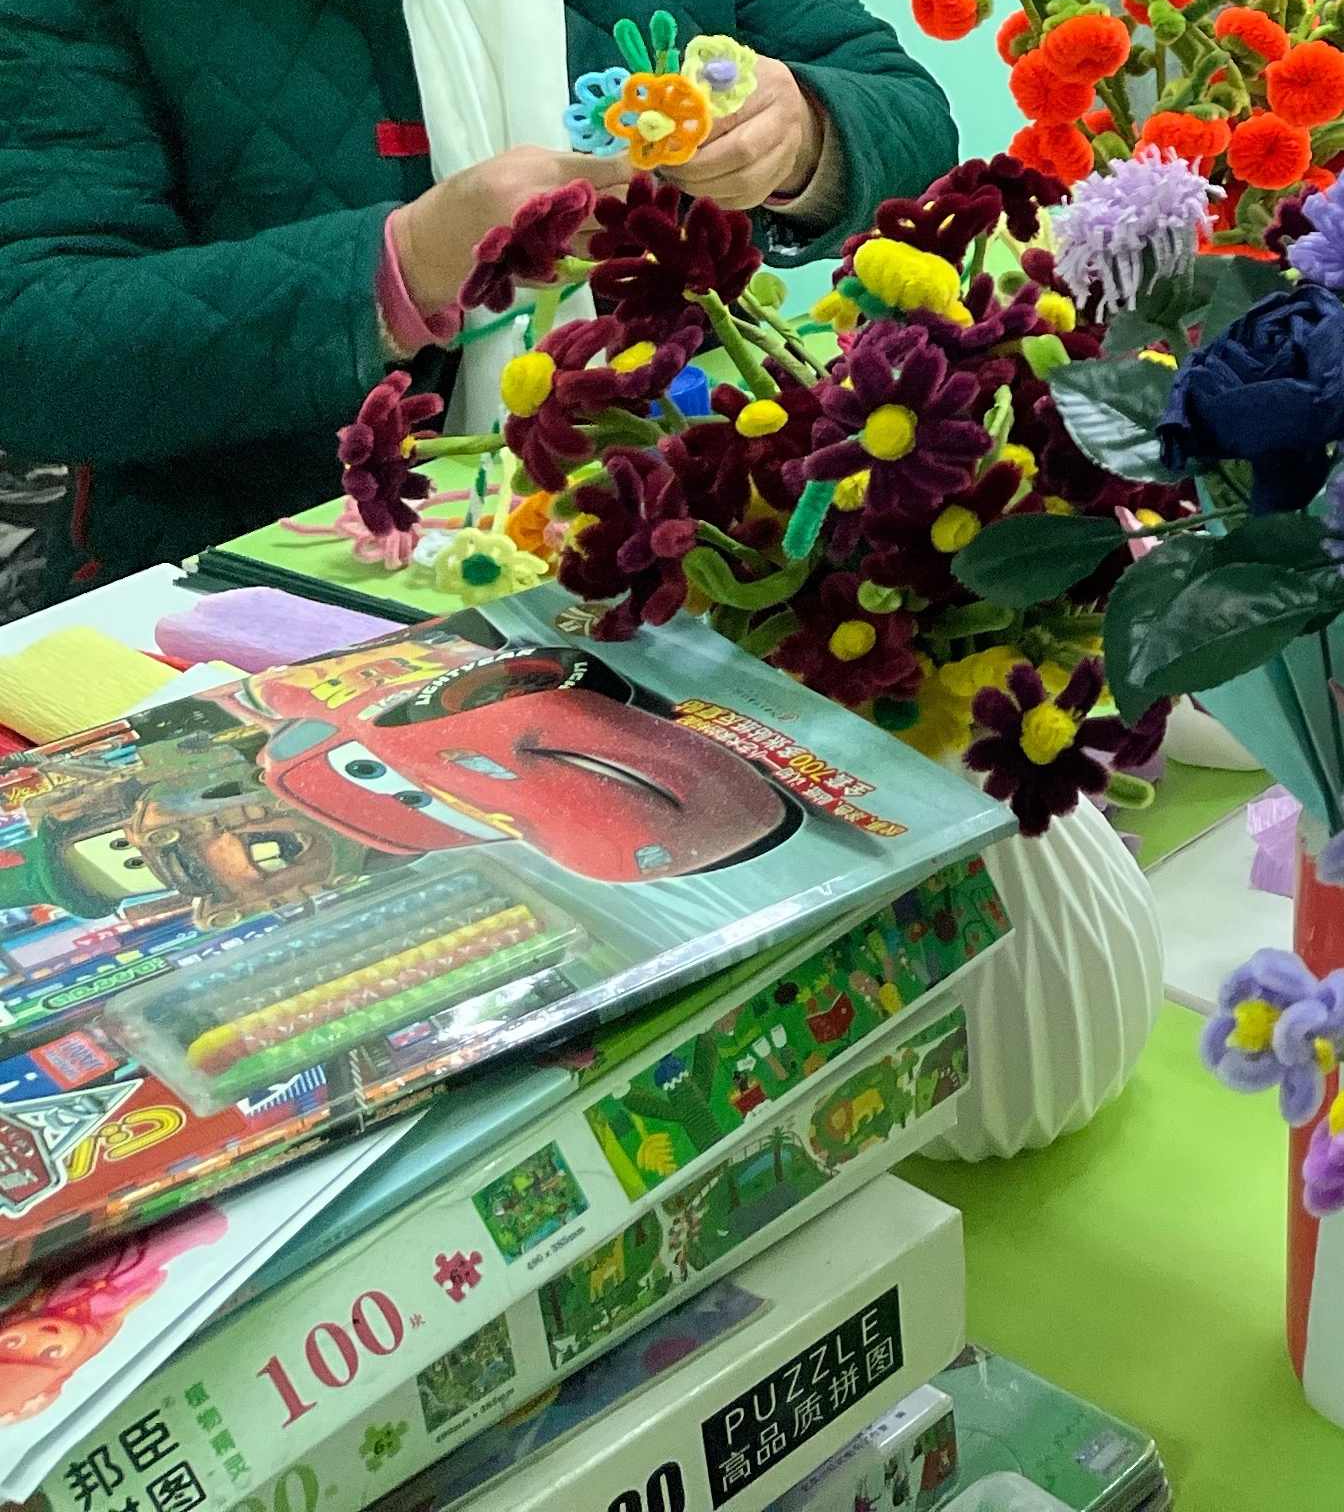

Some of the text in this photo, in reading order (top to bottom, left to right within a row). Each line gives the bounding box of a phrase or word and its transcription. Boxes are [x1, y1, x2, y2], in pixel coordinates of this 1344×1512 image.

[257, 1290, 404, 1429] 100
[718, 1336, 894, 1492] 高品质拼图
[725, 1308, 881, 1445] PUZZLE
[63, 1408, 180, 1512] 邦臣
